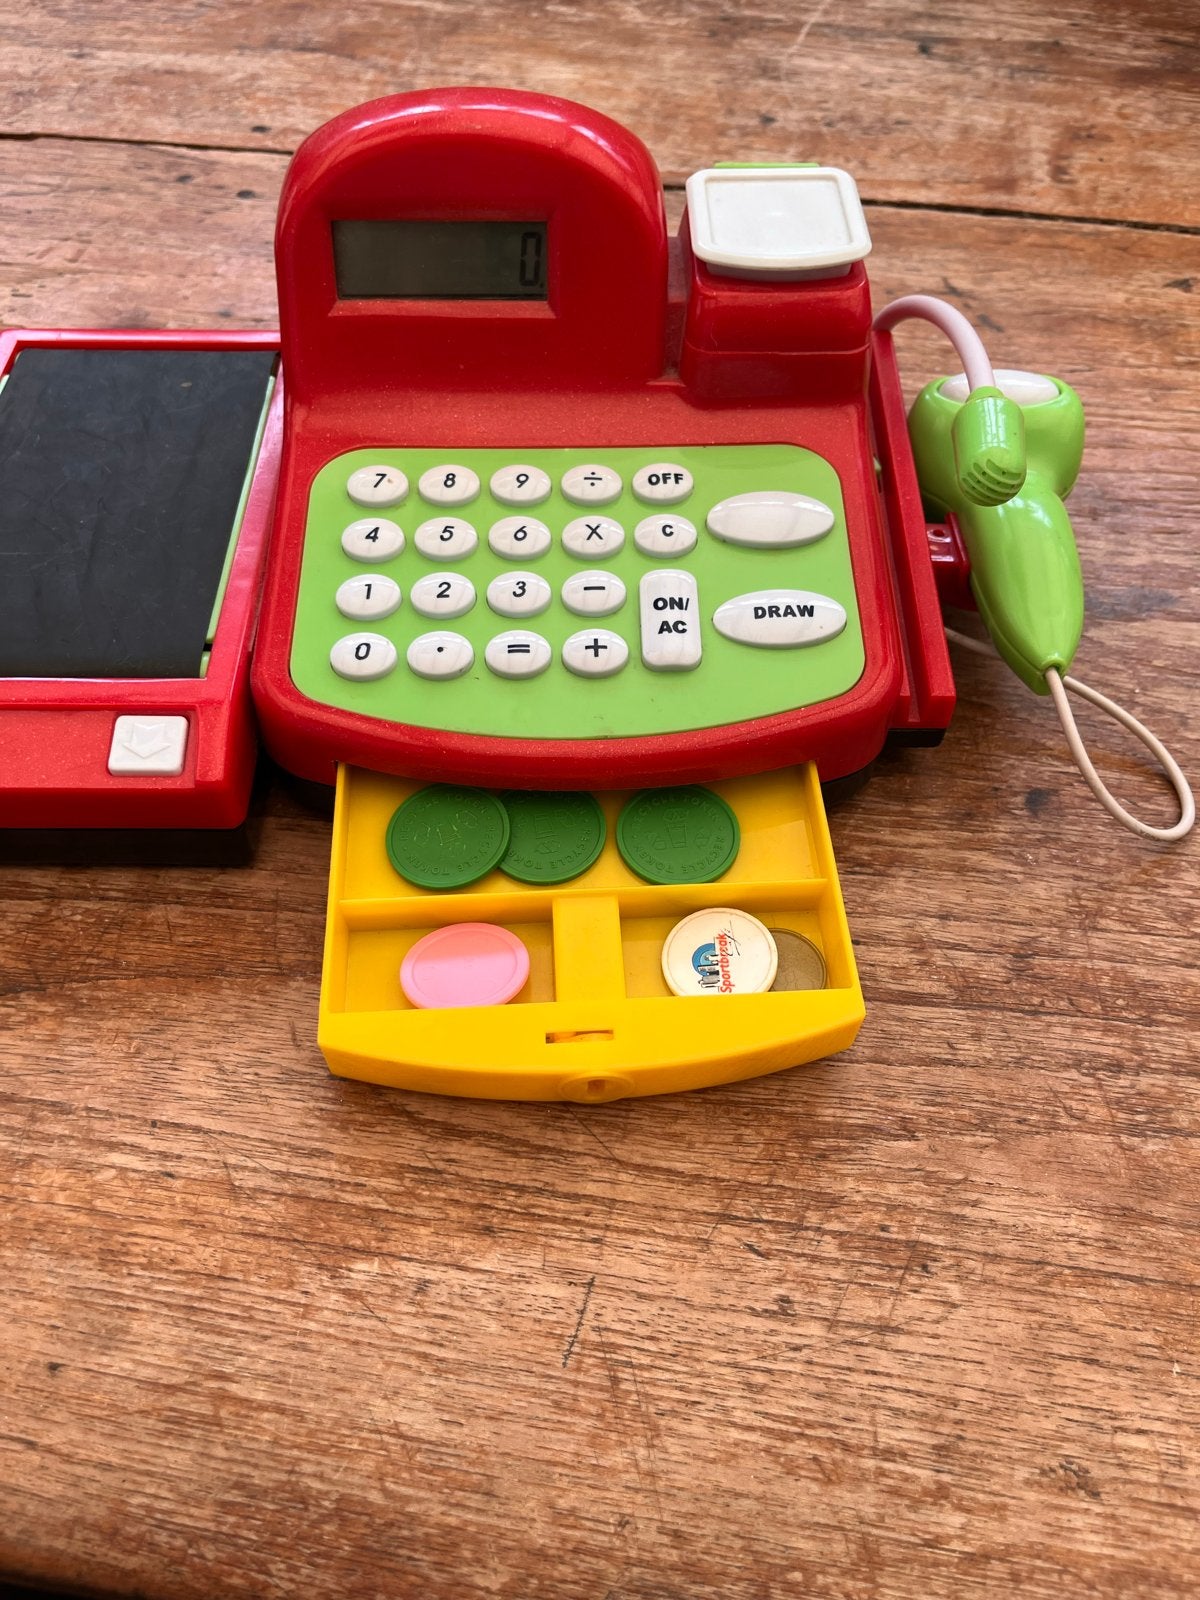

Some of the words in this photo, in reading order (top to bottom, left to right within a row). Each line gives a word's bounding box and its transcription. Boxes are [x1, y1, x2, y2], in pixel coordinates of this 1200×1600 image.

[373, 472, 387, 488] 7
[443, 472, 457, 488] 8
[516, 472, 530, 489] 9
[647, 472, 684, 486] OFF
[365, 526, 380, 543] 4
[438, 525, 455, 542] 5
[513, 525, 528, 542] 6
[661, 524, 674, 537] C
[364, 583, 372, 600] 1
[436, 581, 451, 599] 2
[512, 581, 527, 598] 3
[652, 597, 690, 611] ON/
[753, 604, 815, 620] DRAW
[657, 620, 688, 635] AC
[354, 642, 371, 661] 0
[584, 638, 608, 658] +
[507, 849, 544, 870] TOKE
